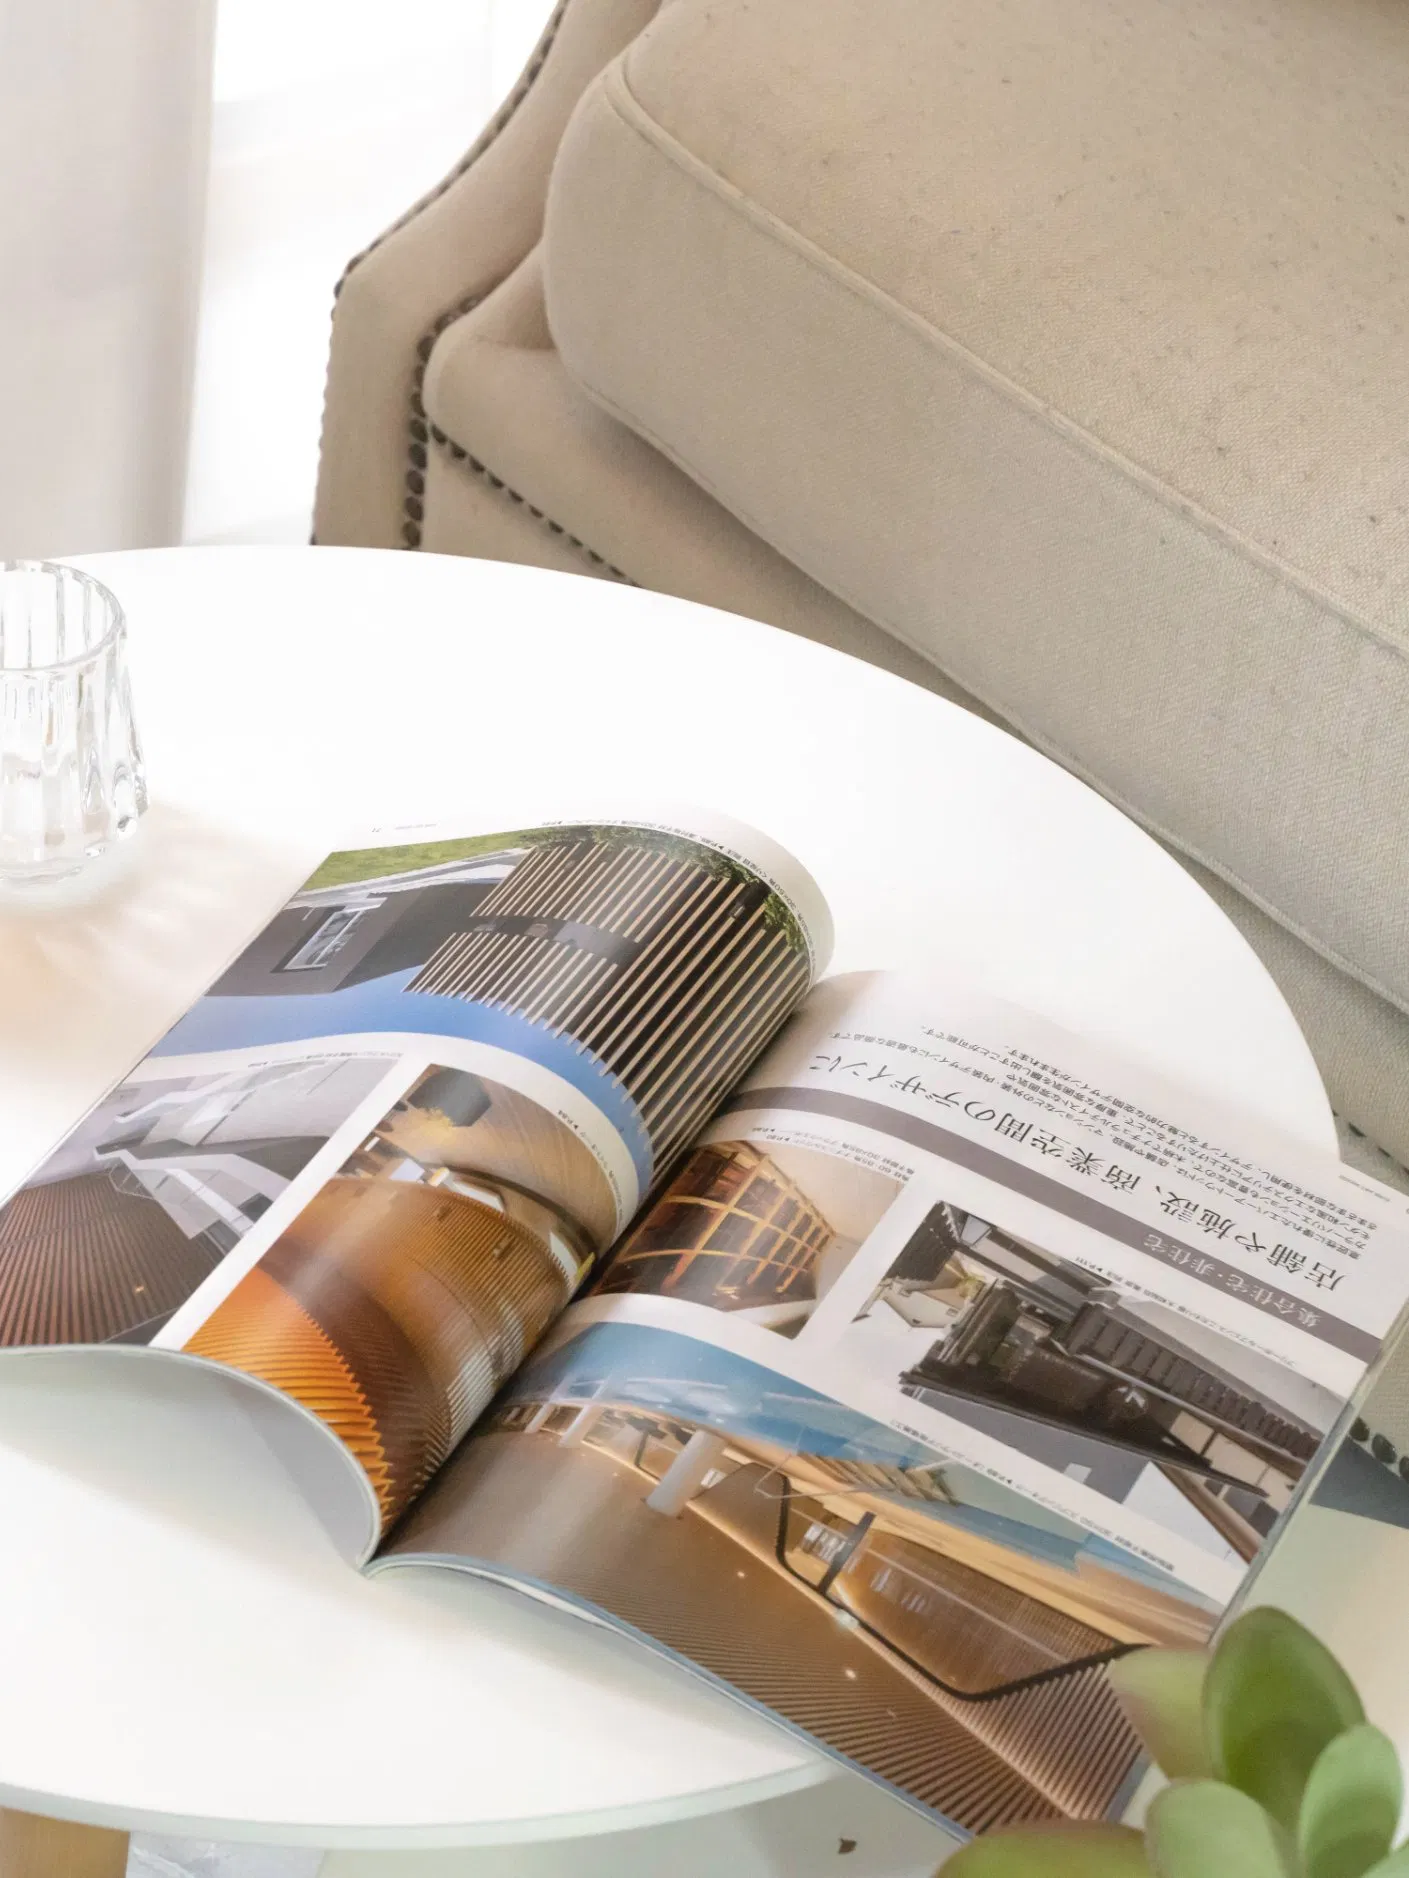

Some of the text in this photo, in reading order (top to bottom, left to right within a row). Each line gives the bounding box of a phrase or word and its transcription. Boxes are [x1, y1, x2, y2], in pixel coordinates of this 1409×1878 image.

[812, 1054, 1346, 1291] 店舗や施設、商業空間のデザインに
[1143, 1231, 1321, 1328] 集合住宅・非住宅
